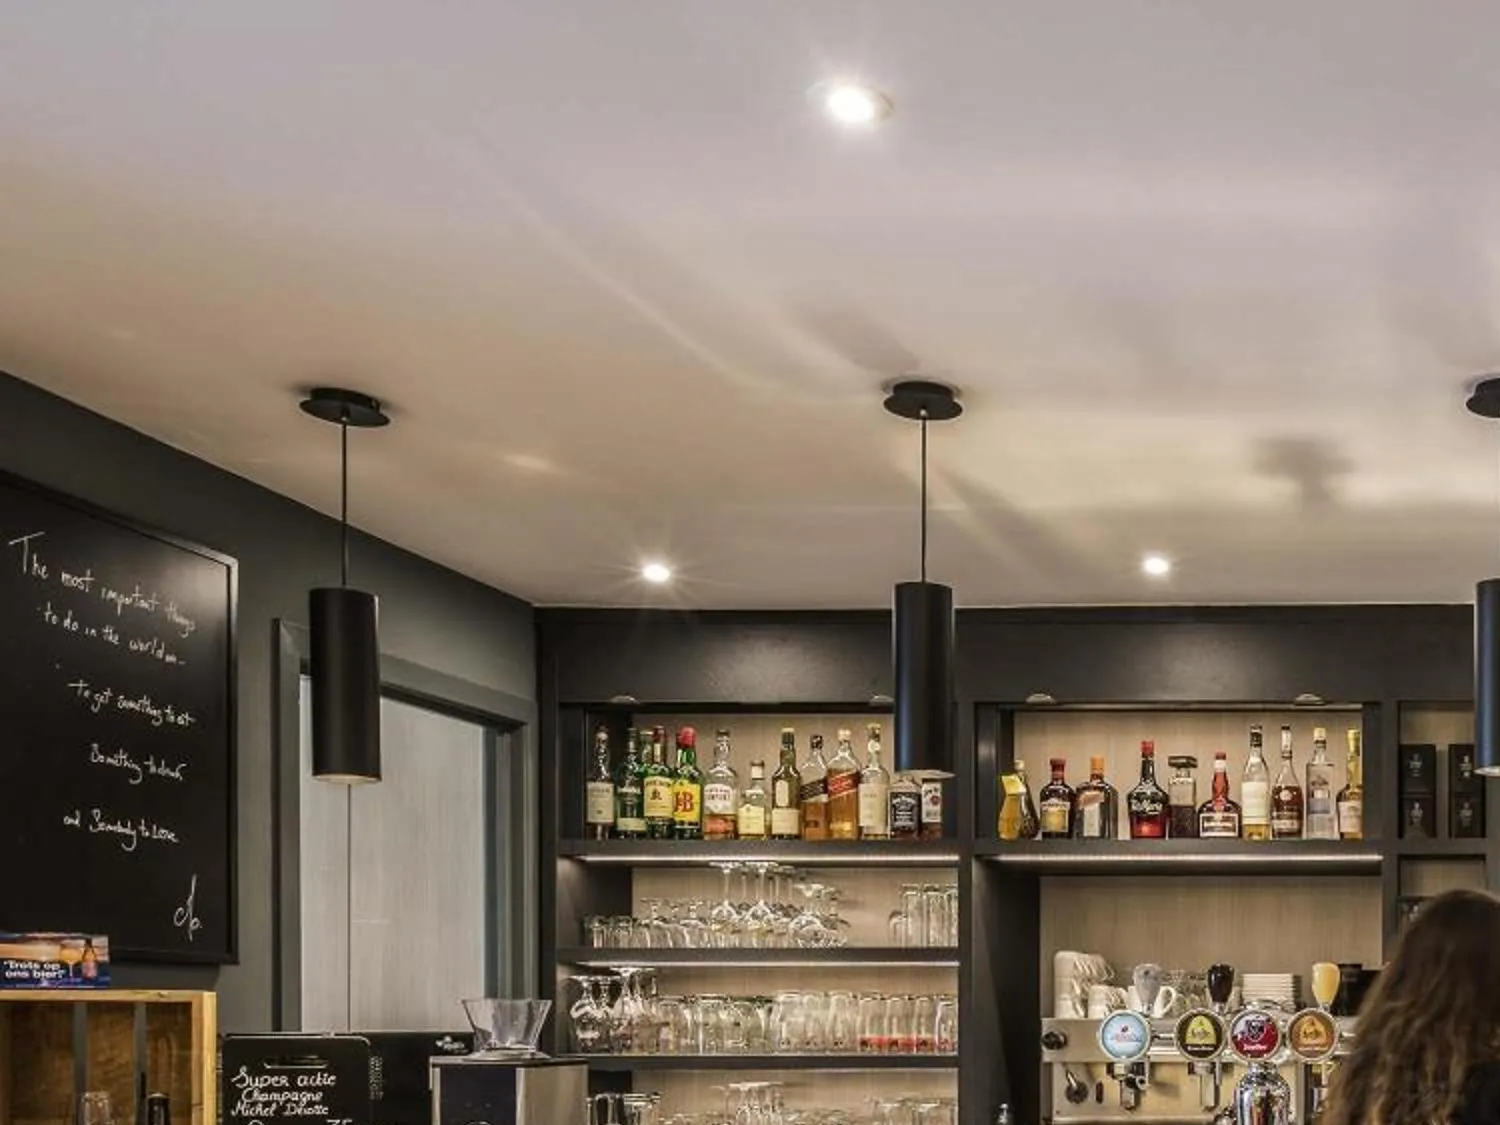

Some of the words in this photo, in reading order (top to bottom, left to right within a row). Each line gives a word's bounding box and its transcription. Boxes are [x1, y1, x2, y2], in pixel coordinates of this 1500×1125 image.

[8, 531, 49, 580] The
[61, 569, 95, 593] most
[43, 601, 58, 625] to
[63, 609, 79, 631] do
[102, 624, 120, 645] the
[129, 637, 166, 660] world
[63, 809, 81, 828] and
[231, 1065, 290, 1088] Super
[241, 1087, 324, 1107] Champagne
[231, 1100, 277, 1117] Michel
